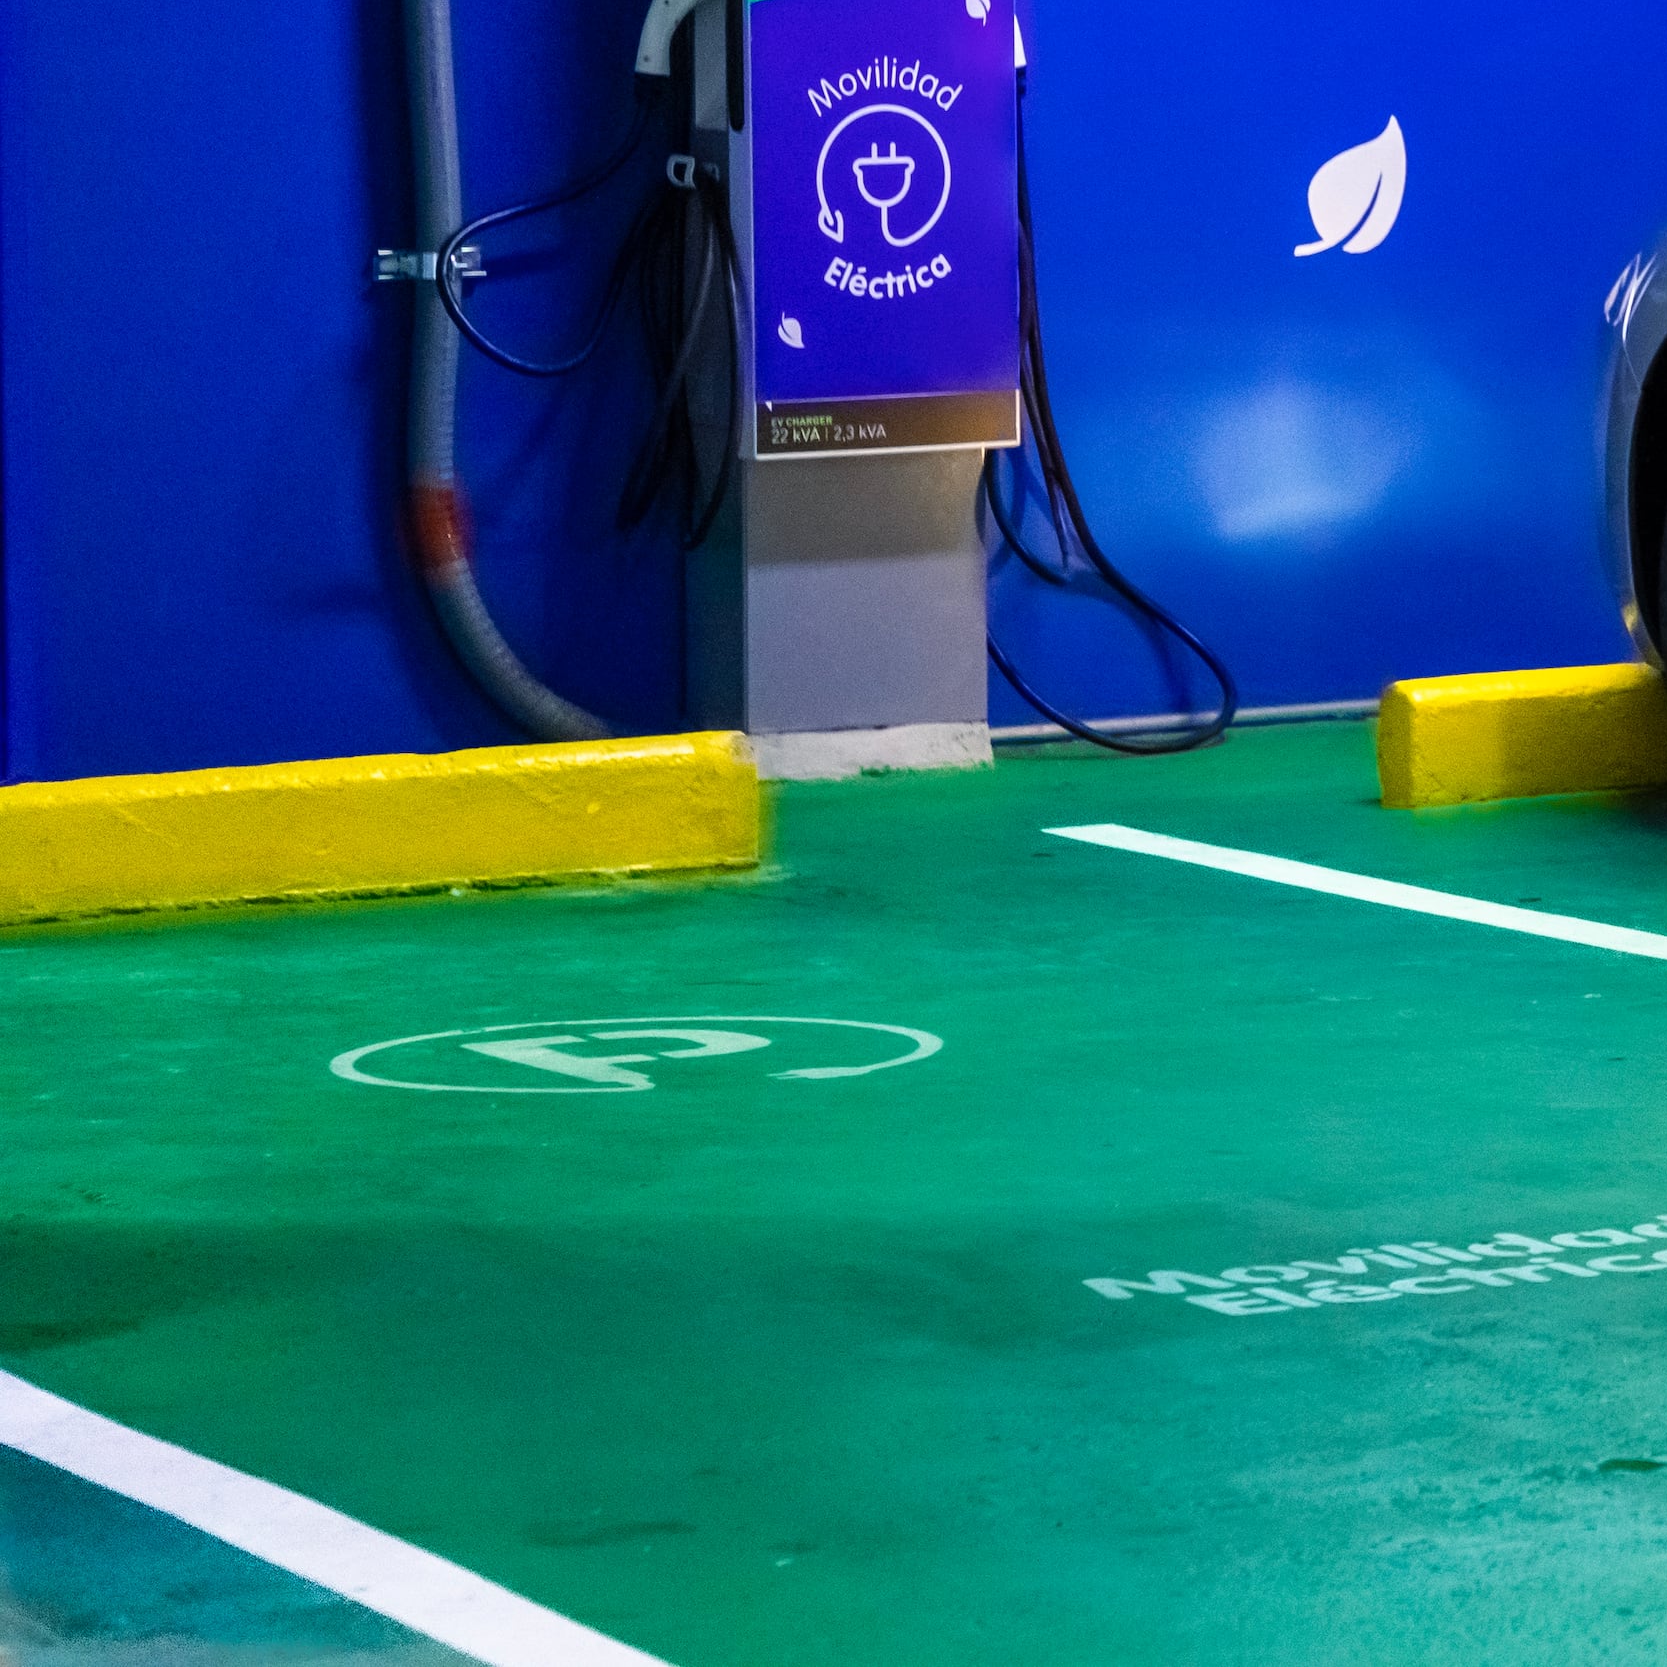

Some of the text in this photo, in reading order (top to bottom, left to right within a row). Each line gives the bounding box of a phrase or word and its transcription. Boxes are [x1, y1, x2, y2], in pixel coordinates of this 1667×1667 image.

[807, 56, 963, 117] Movilidad
[823, 253, 952, 299] Eléctrica
[771, 428, 788, 444] 22
[793, 426, 820, 443] kVA
[859, 423, 887, 439] kVA
